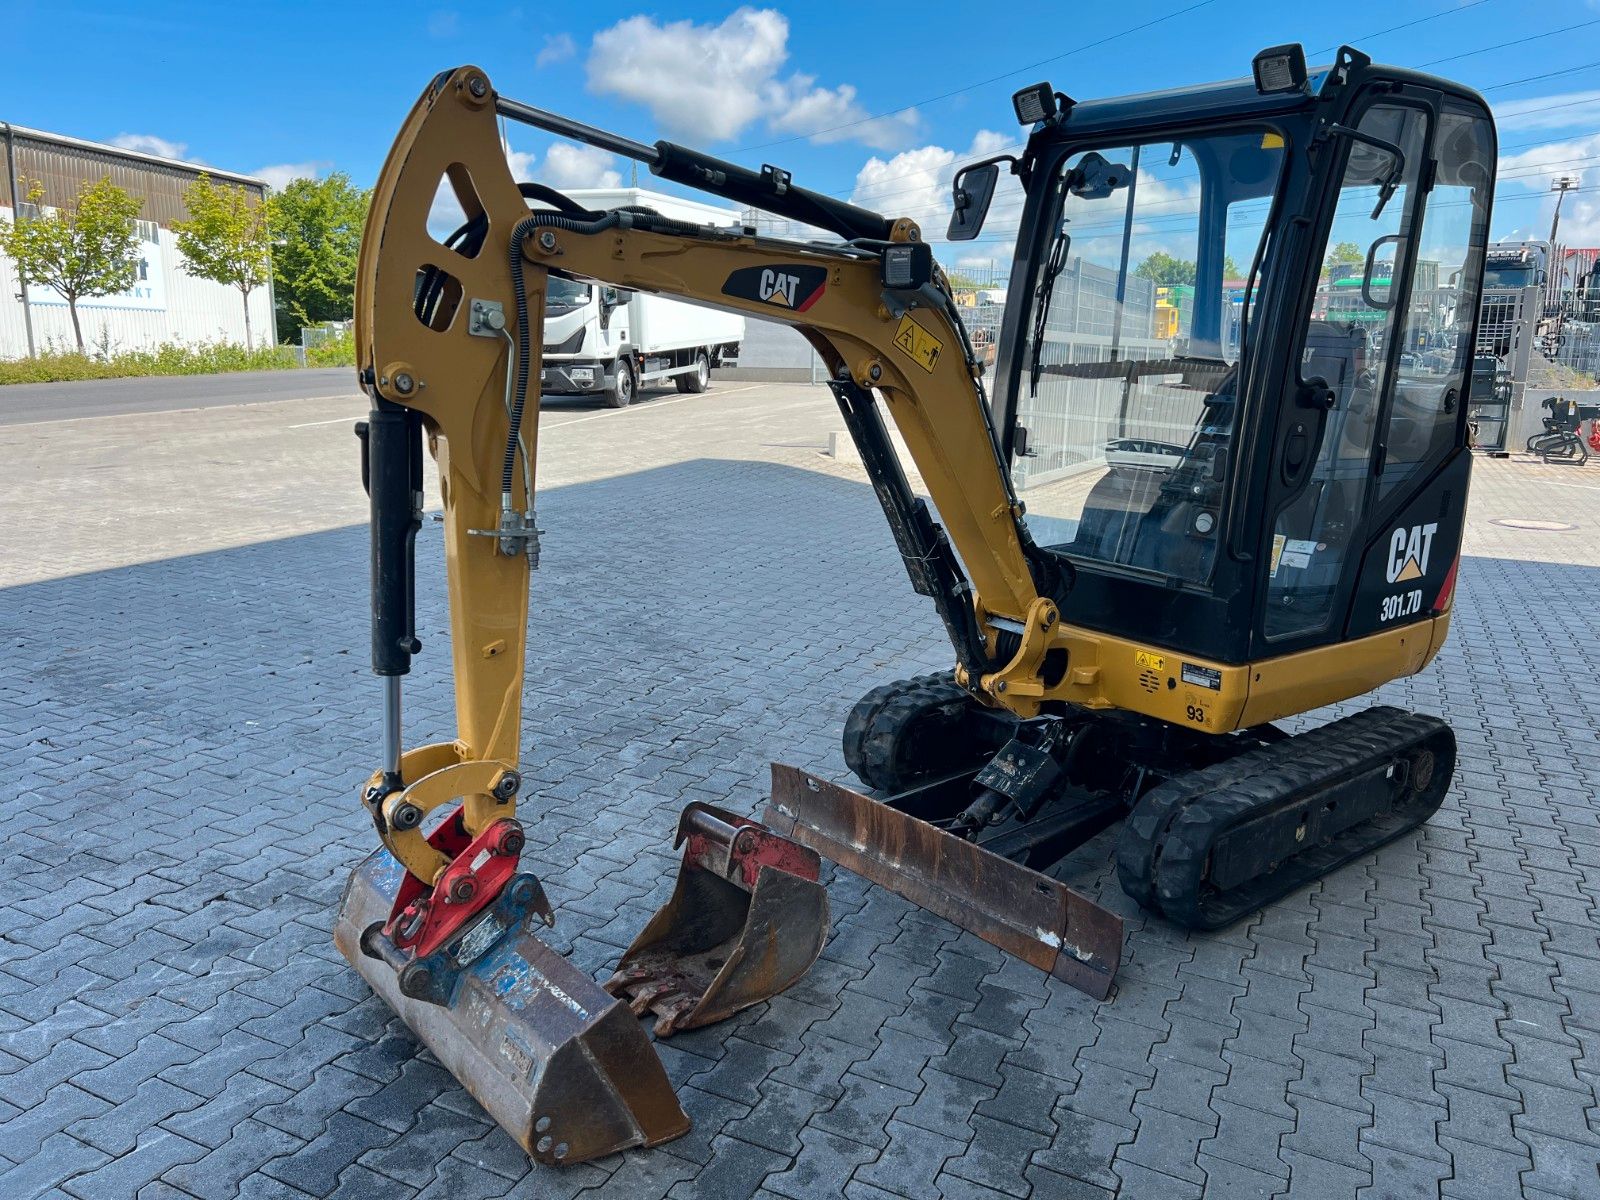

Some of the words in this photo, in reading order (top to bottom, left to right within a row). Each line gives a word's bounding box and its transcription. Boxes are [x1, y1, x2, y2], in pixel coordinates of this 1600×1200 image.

[759, 268, 800, 307] CAT
[1386, 523, 1438, 584] CAT
[1380, 589, 1423, 622] 301.7D
[1187, 705, 1204, 722] 93
